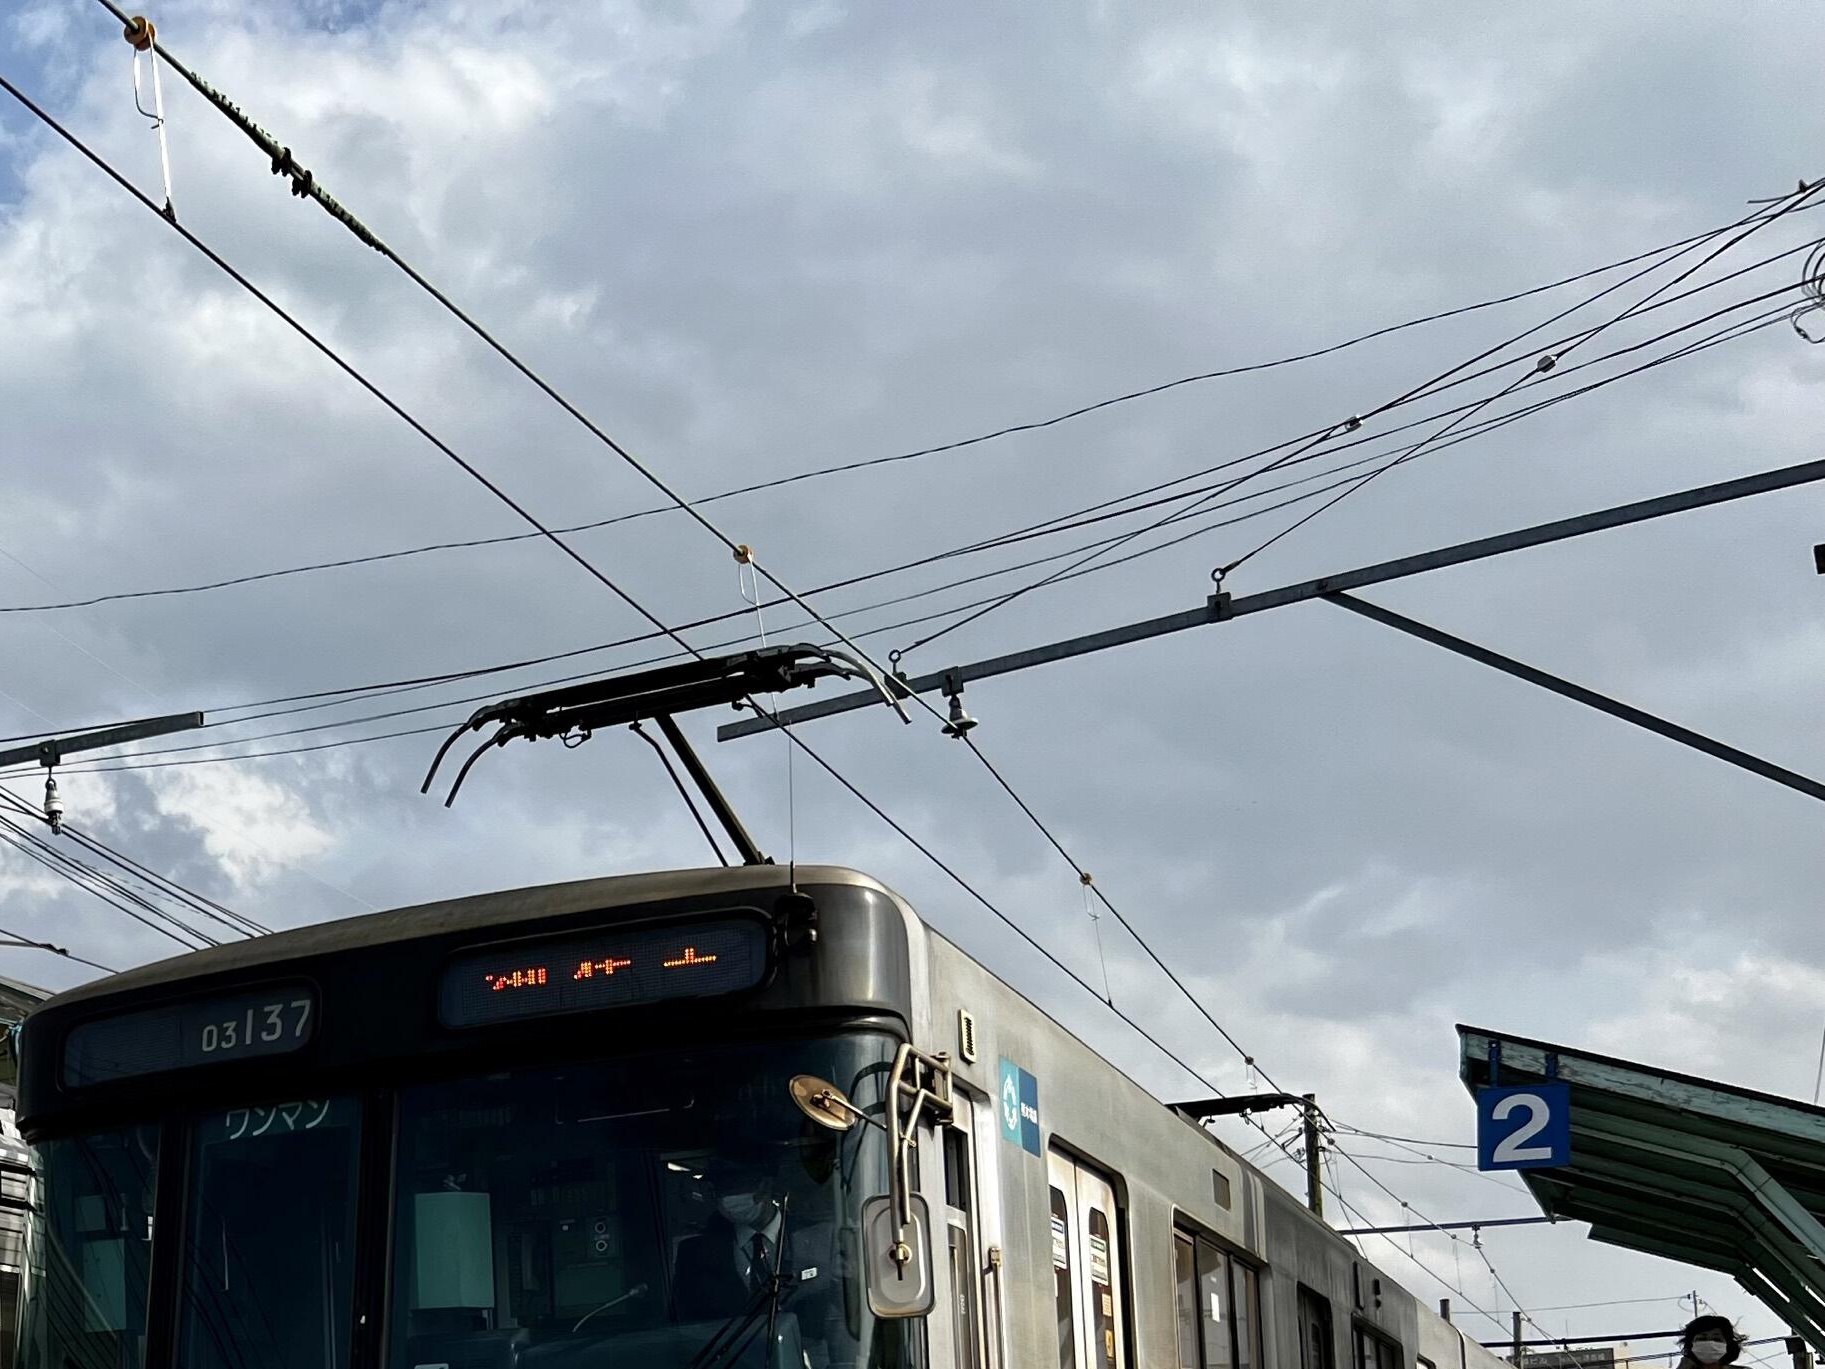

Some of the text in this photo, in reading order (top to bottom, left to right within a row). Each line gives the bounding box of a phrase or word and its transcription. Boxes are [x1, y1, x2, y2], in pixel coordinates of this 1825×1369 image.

[201, 999, 311, 1052] 03137
[225, 1099, 330, 1140] ワンマン
[1492, 1093, 1552, 1163] 2
